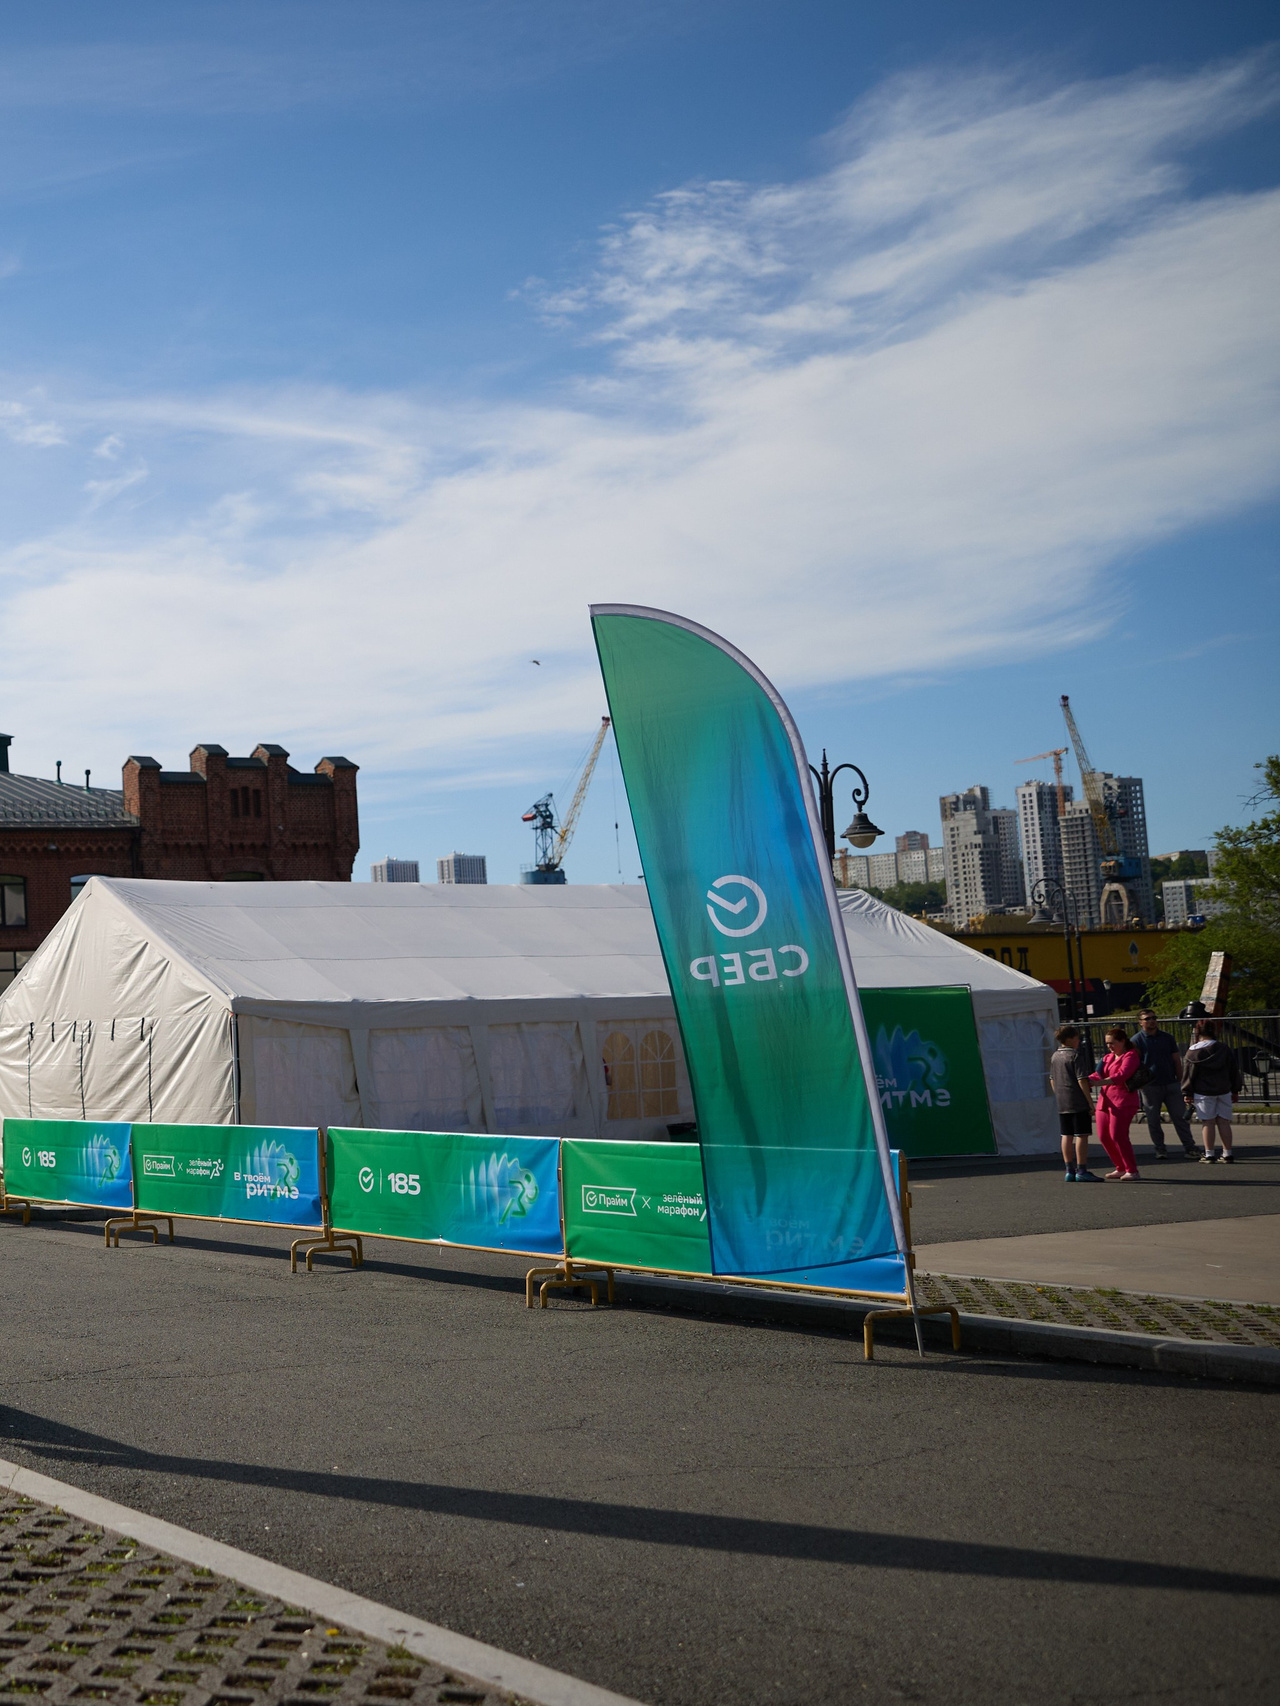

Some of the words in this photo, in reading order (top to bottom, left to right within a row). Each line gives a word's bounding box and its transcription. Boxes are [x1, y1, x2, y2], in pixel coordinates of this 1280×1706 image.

[37, 1151, 56, 1168] 185
[188, 1158, 213, 1168] зелёный
[151, 1160, 171, 1173] Прайм
[186, 1166, 211, 1177] марафон
[243, 1170, 271, 1183] твоём
[387, 1172, 421, 1195] 185
[246, 1182, 300, 1199] ритме
[598, 1193, 628, 1208] Прайм
[662, 1192, 703, 1205] зелёный
[657, 1204, 700, 1217] марафон
